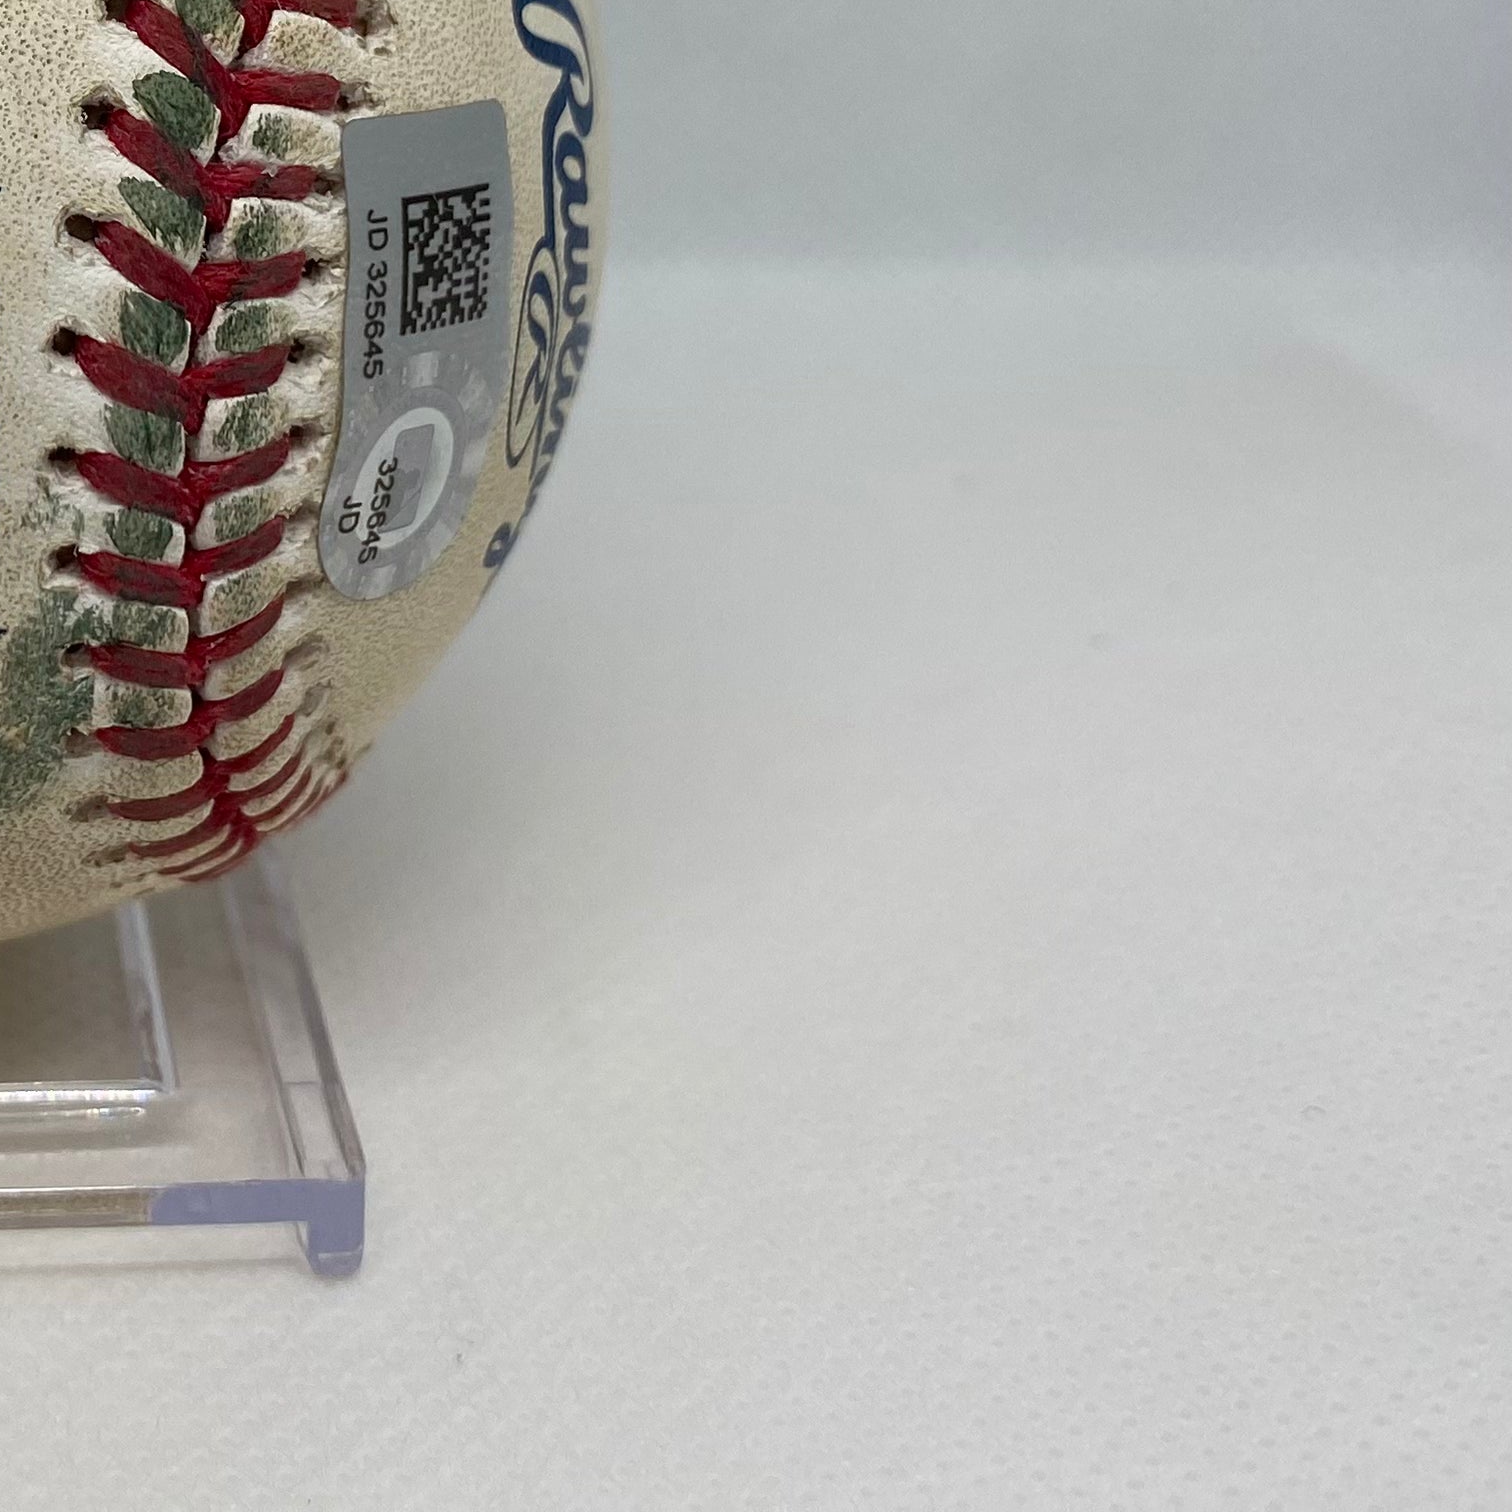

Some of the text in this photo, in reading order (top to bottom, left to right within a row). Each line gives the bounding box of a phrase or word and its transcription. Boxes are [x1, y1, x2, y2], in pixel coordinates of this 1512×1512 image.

[362, 208, 389, 381] JD 325645
[337, 495, 360, 534] JD
[357, 456, 399, 565] 325645
